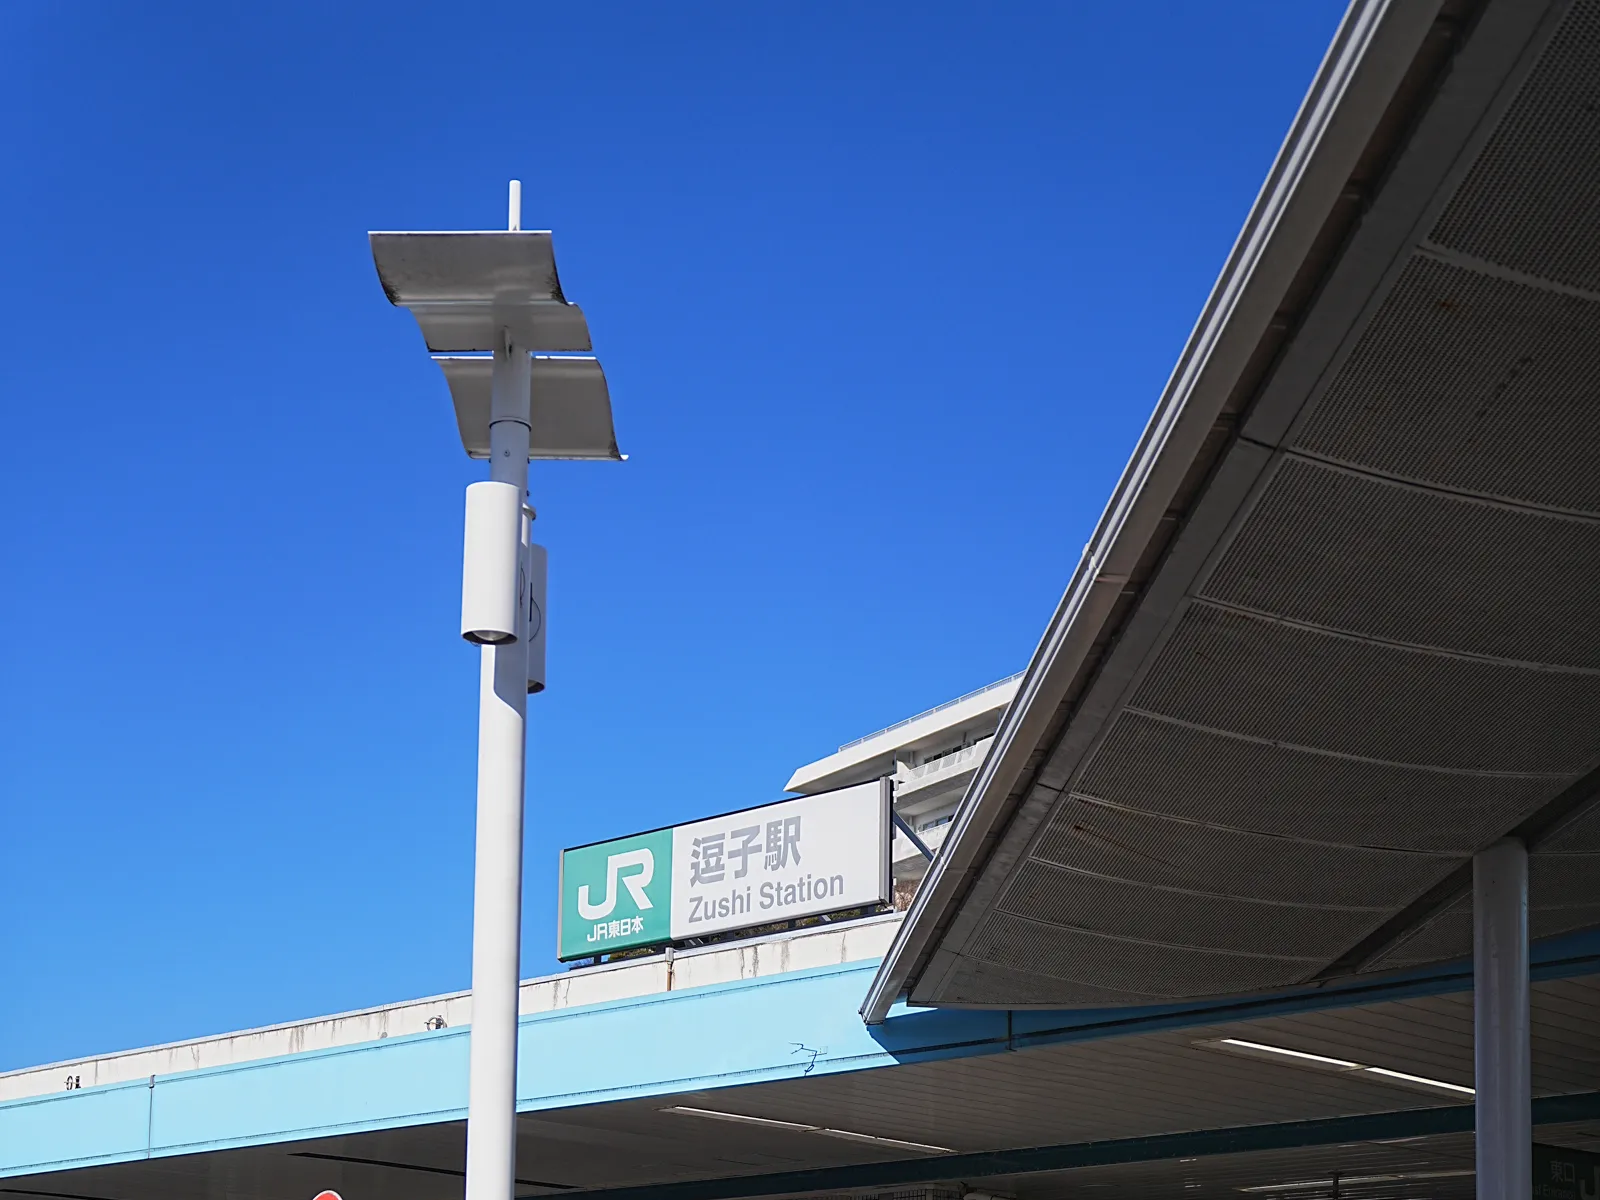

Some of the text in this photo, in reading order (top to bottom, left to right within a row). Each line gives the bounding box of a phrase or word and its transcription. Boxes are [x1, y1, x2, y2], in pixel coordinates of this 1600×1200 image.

[689, 815, 802, 887] 逗子駅
[577, 847, 655, 920] JR
[688, 874, 844, 924] Zushi Station
[586, 916, 644, 942] JR東日本
[1549, 1159, 1575, 1184] 東口
